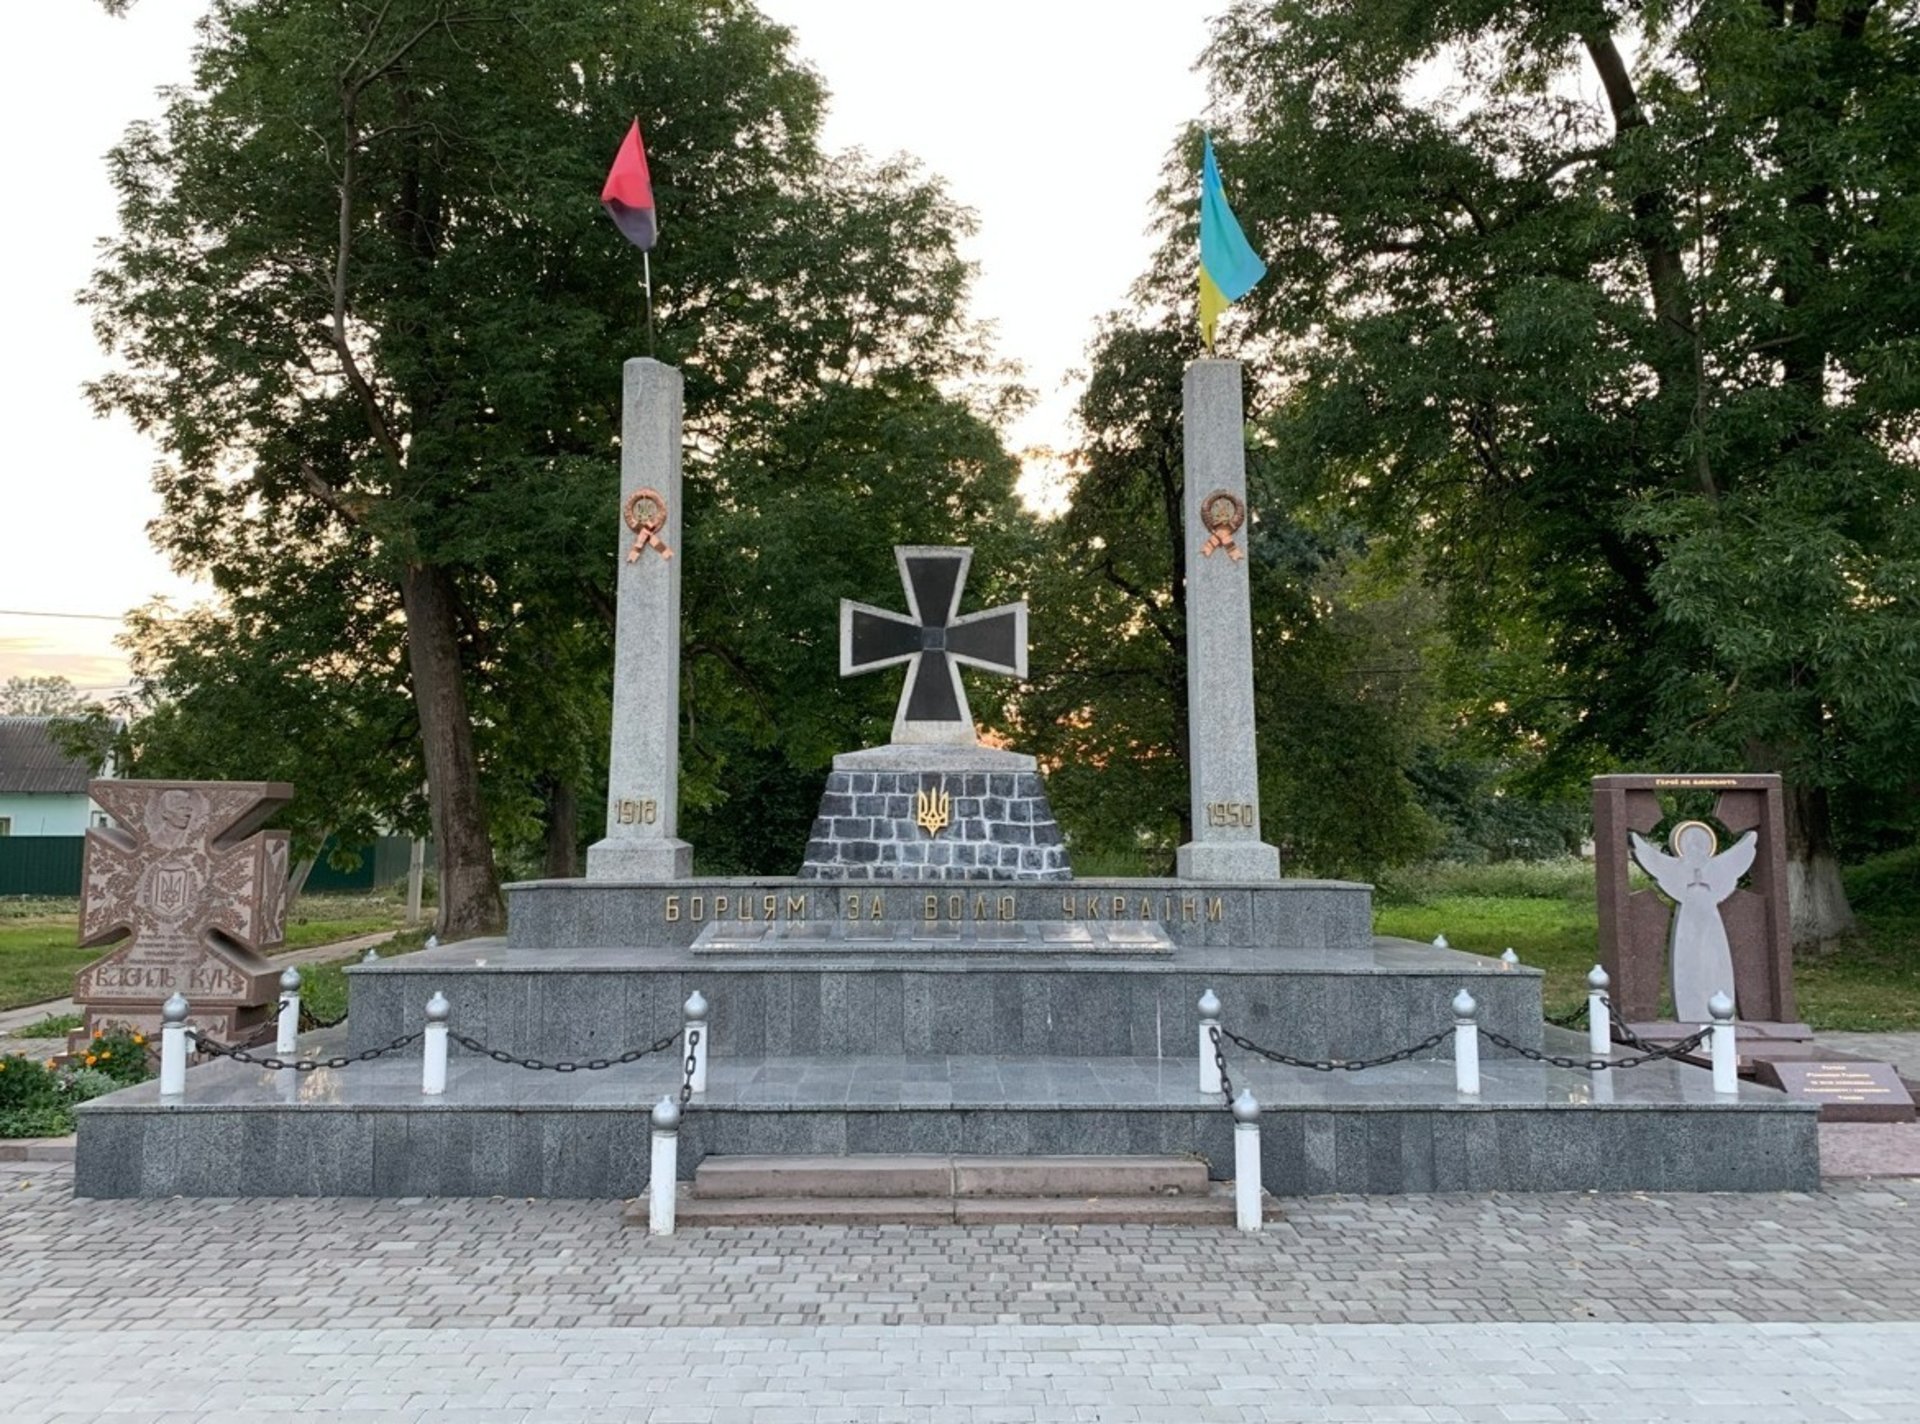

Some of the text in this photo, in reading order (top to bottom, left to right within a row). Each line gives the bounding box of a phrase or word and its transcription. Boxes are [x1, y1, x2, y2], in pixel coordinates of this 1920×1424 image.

[1206, 801, 1255, 827] 1950
[664, 895, 805, 922] БОРЦЯМ
[847, 895, 883, 920] ЗА
[924, 895, 1015, 920] ВОЛЮ
